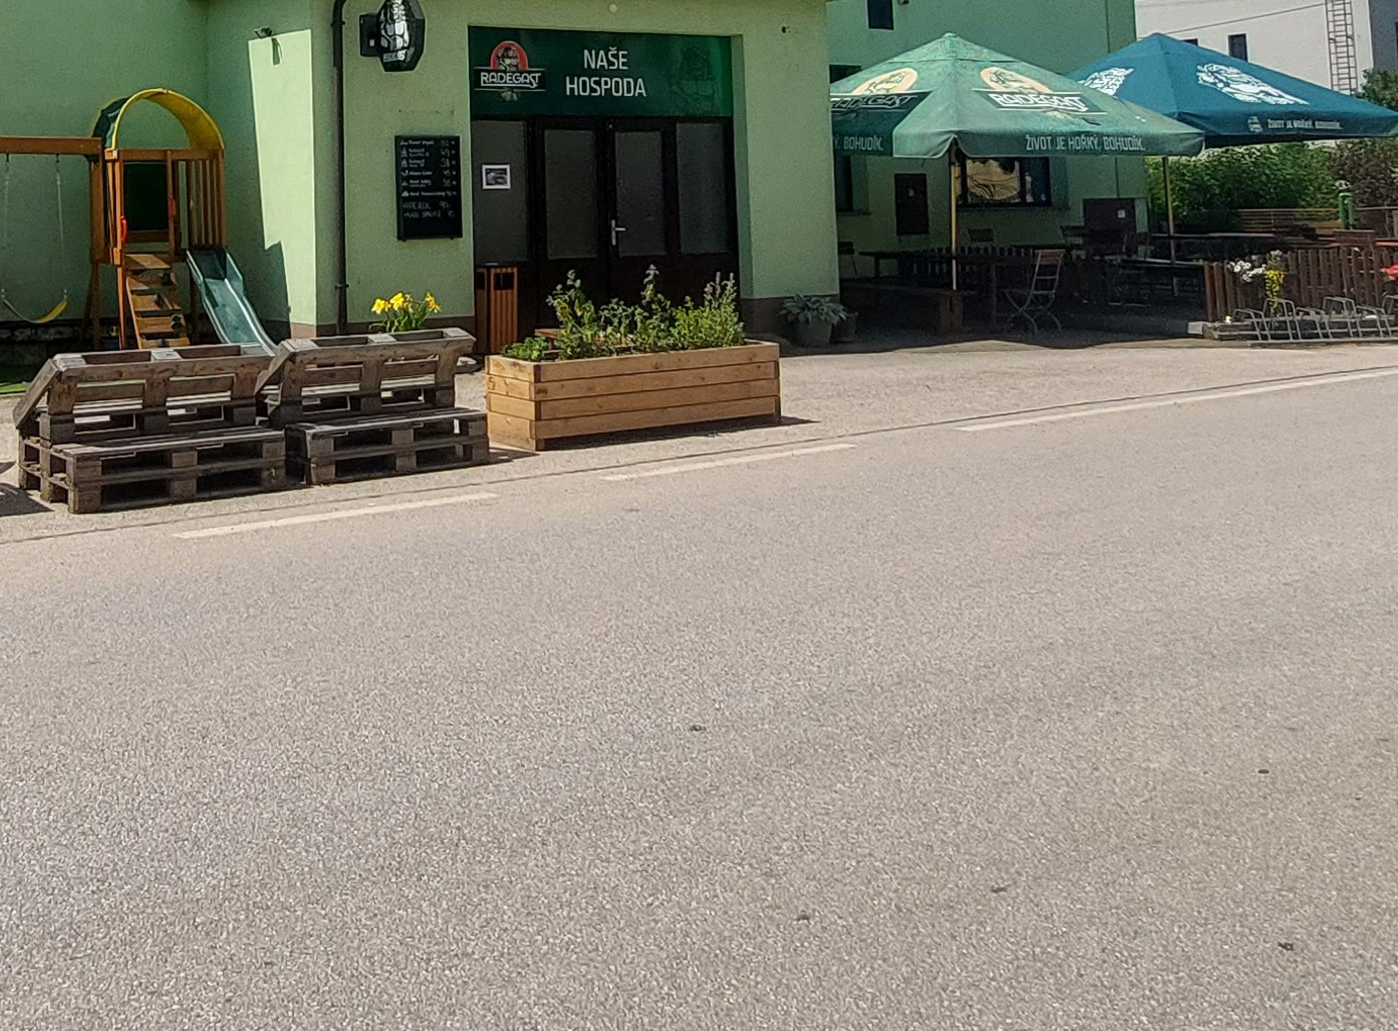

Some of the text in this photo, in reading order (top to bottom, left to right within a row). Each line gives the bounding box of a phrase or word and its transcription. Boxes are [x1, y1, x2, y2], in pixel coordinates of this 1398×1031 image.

[583, 47, 629, 70] NAŠE
[480, 72, 542, 89] RADEGAST
[565, 76, 647, 98] HOSPODA
[987, 93, 1089, 112] RADEGAST
[1025, 134, 1052, 151] ŽIVOT
[1056, 135, 1066, 151] JE
